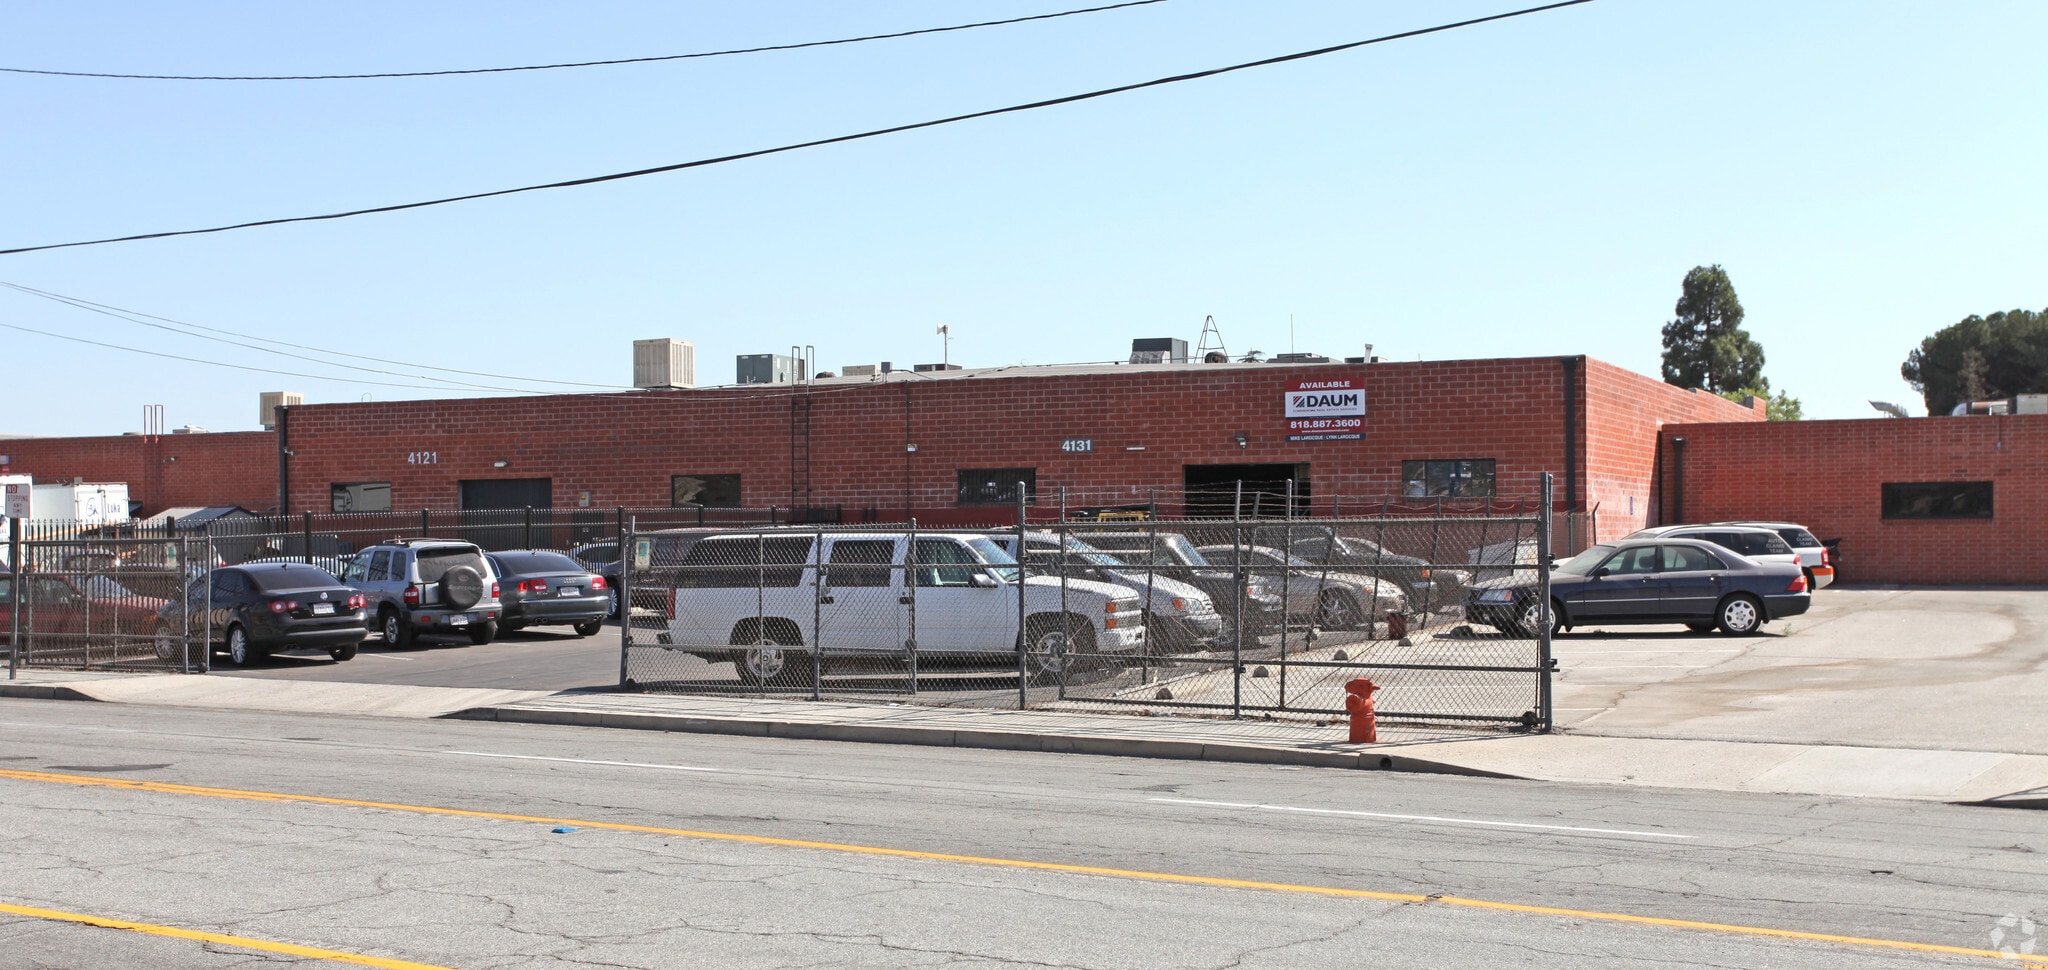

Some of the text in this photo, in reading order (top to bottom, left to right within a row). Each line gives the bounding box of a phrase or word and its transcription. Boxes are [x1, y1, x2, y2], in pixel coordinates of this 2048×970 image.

[1300, 381, 1350, 389] AVAILABLE
[1307, 394, 1357, 407] DAUM
[1290, 419, 1361, 428] 818.887.3600
[1062, 440, 1091, 451] 4131
[408, 451, 437, 464] 4121
[7, 485, 17, 493] NO
